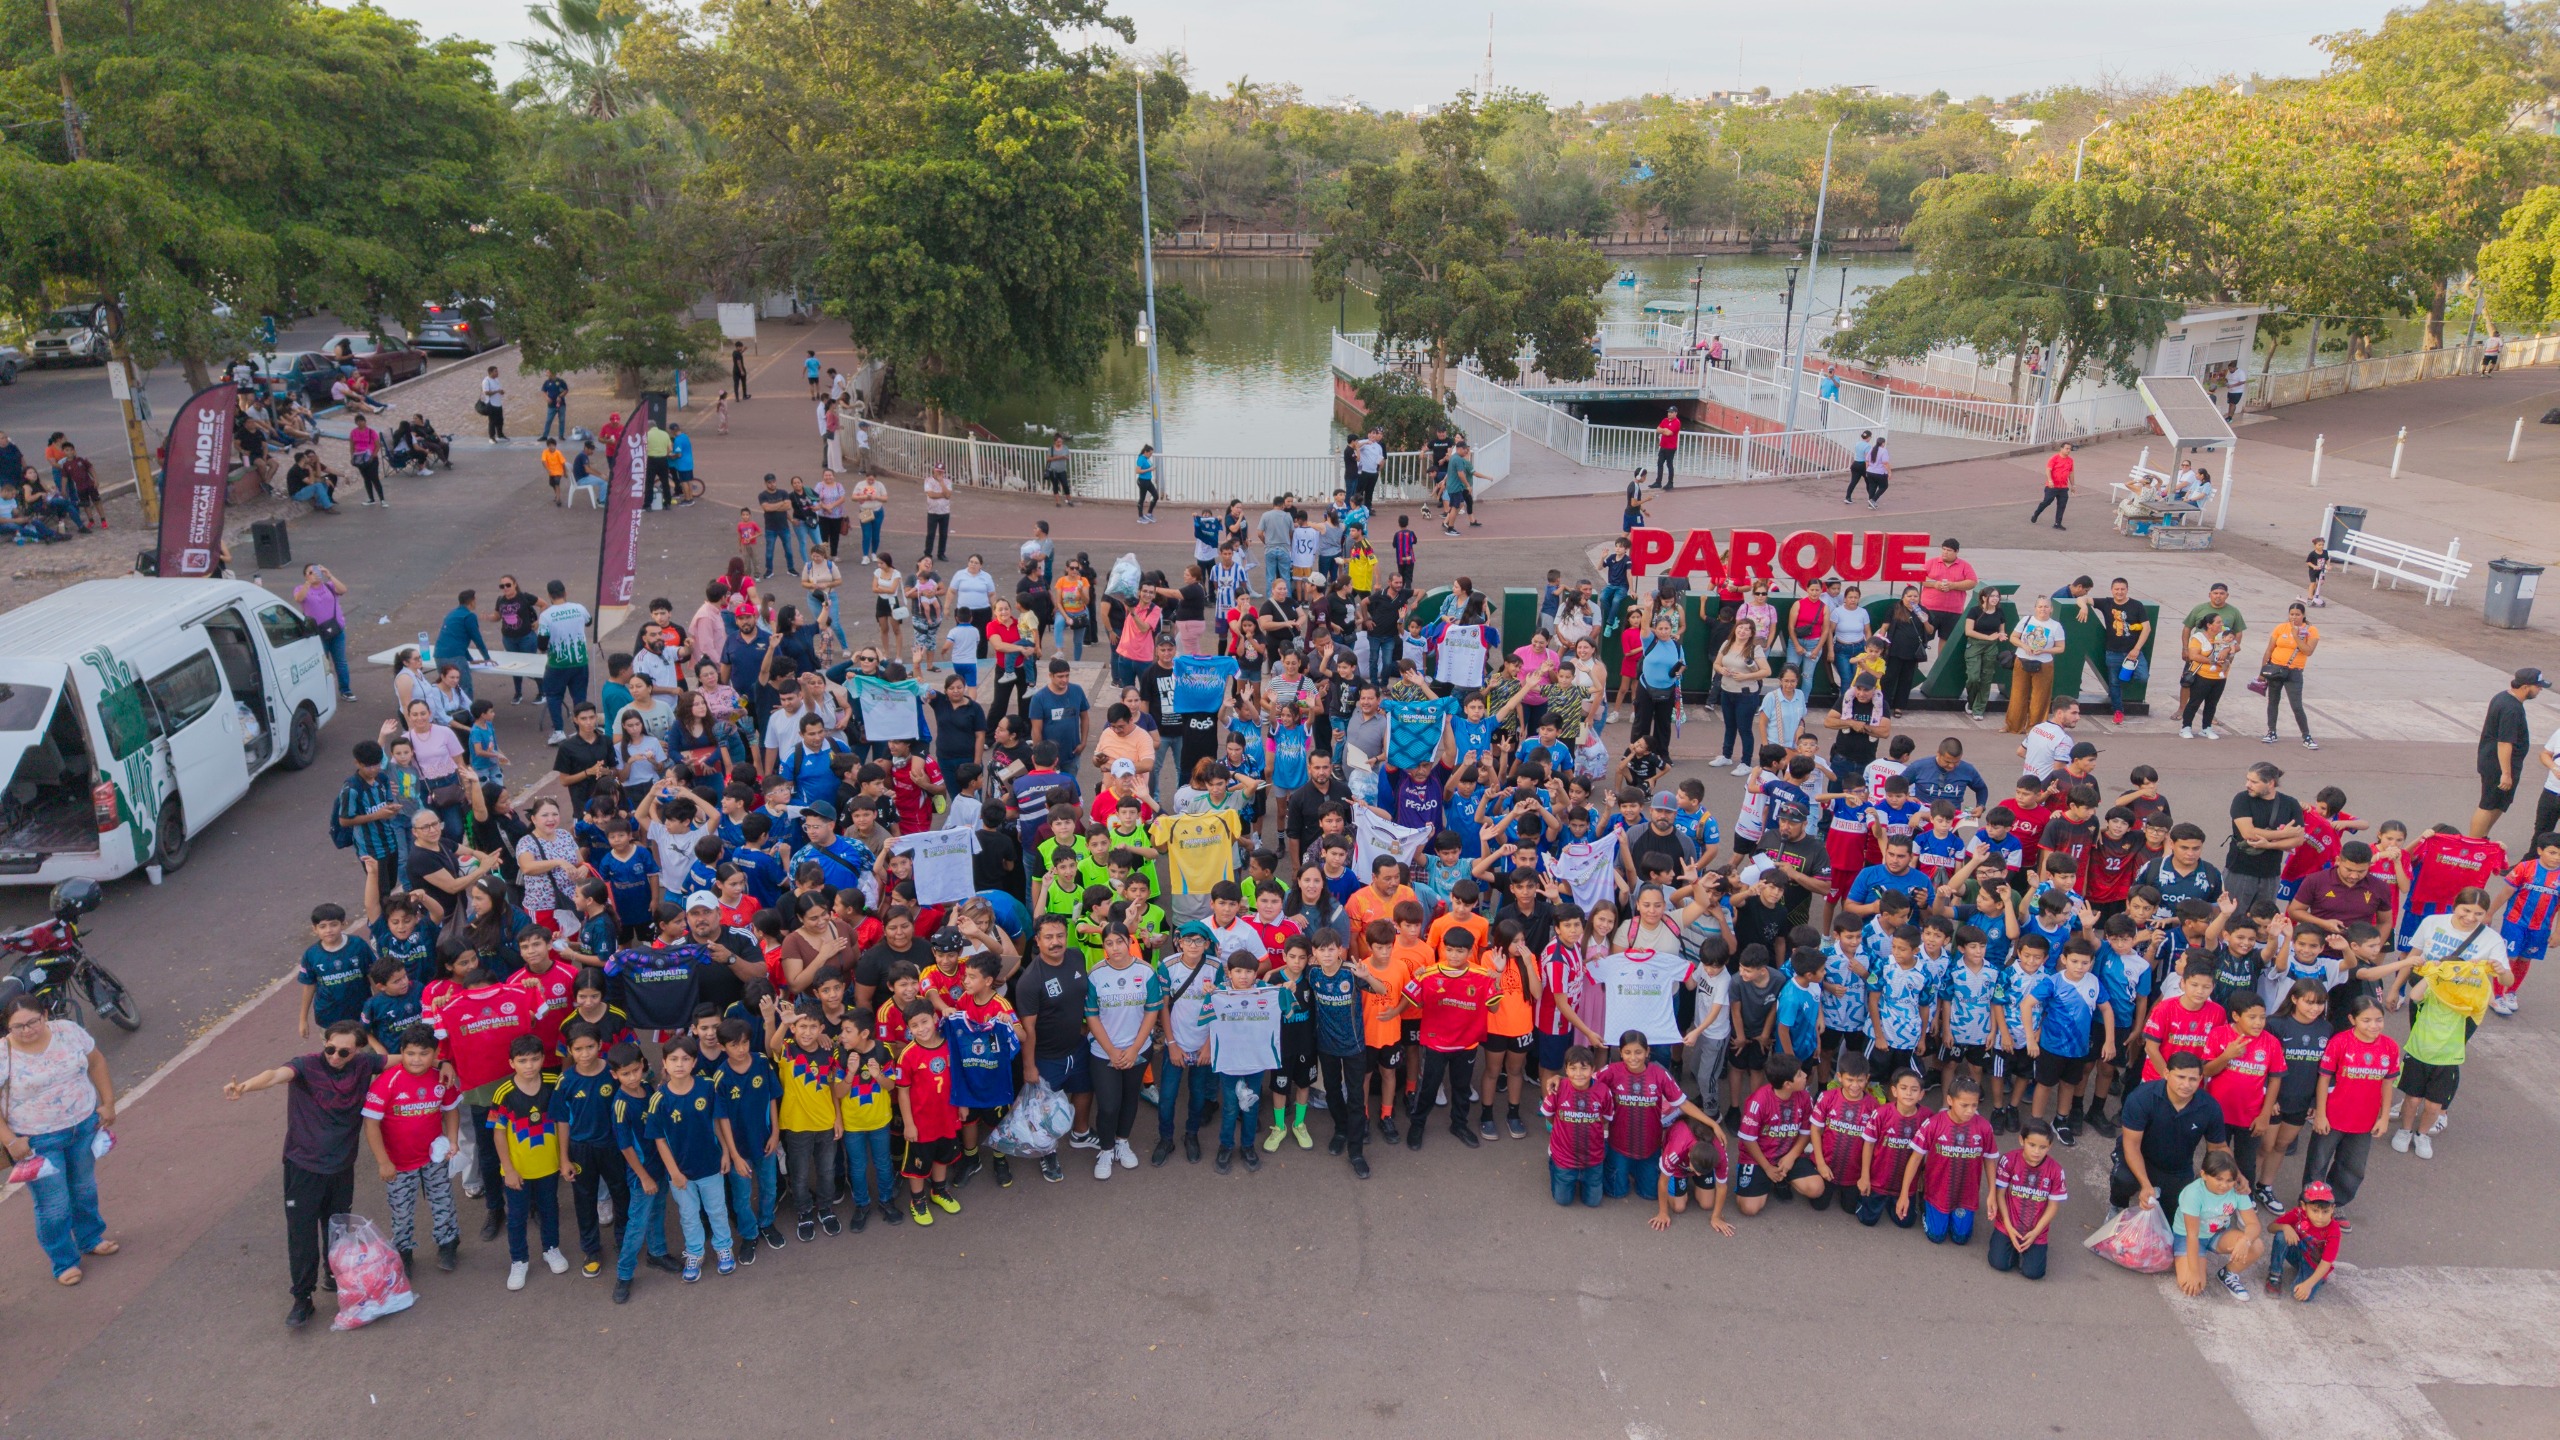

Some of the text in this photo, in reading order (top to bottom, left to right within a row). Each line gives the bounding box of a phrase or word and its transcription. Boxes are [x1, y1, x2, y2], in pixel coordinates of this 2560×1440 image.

[194, 408, 216, 475] IMDEC
[627, 433, 644, 498] IMDEC
[188, 485, 200, 544] AYUNTAMIENTO DE
[194, 485, 211, 544] CULIACÁN
[631, 509, 636, 519] DE
[1630, 527, 1931, 591] PARQUE
[550, 608, 581, 618] CAPITAL
[1190, 717, 1214, 730] BOSS
[1470, 734, 1482, 744] 24
[1871, 764, 1896, 776] GUSTAVO
[1405, 799, 1438, 812] PEGASO
[1464, 804, 1475, 816] 20
[2071, 844, 2083, 858] 17
[2106, 857, 2122, 870] 22
[2442, 855, 2482, 868] MUNDIALITO
[641, 968, 688, 978] MUNDIALITO
[467, 1015, 518, 1030] MUNDIALITO
[469, 1025, 490, 1034] CLN
[1516, 1032, 1534, 1048] 122
[934, 1076, 944, 1093] 7
[1829, 1125, 1846, 1134] CLN
[1941, 1145, 1983, 1153] MUNDIALITO
[2011, 1190, 2029, 1199] CLN
